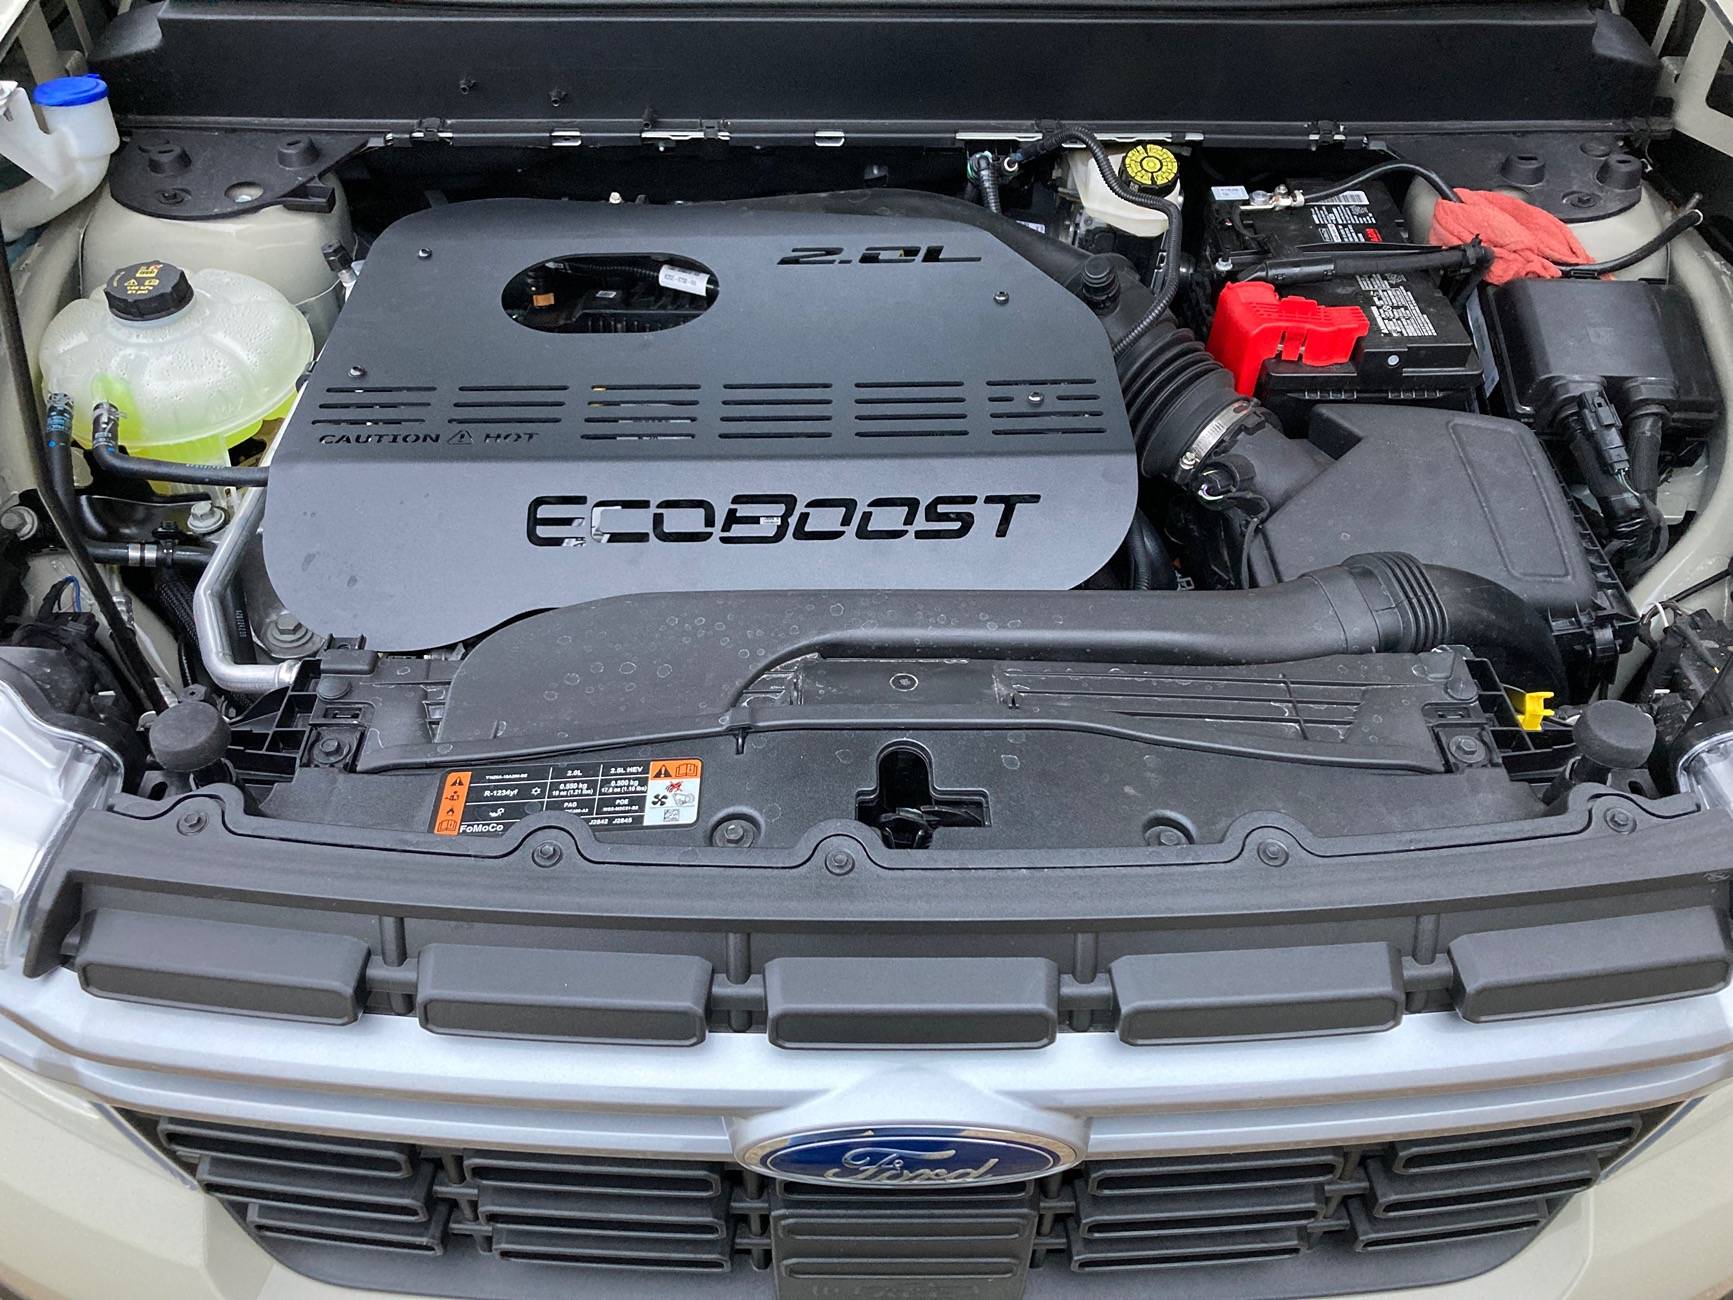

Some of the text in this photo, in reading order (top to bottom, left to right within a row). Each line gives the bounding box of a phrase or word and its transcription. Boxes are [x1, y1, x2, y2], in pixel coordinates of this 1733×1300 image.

[777, 245, 982, 265] 2.0L
[319, 433, 539, 444] CAUTION HOT
[566, 769, 583, 777] 2.0L
[483, 789, 518, 797] R-1234yf
[636, 784, 648, 792] lbs)
[459, 823, 504, 833] FoMoCo
[824, 1147, 999, 1184] Ford
